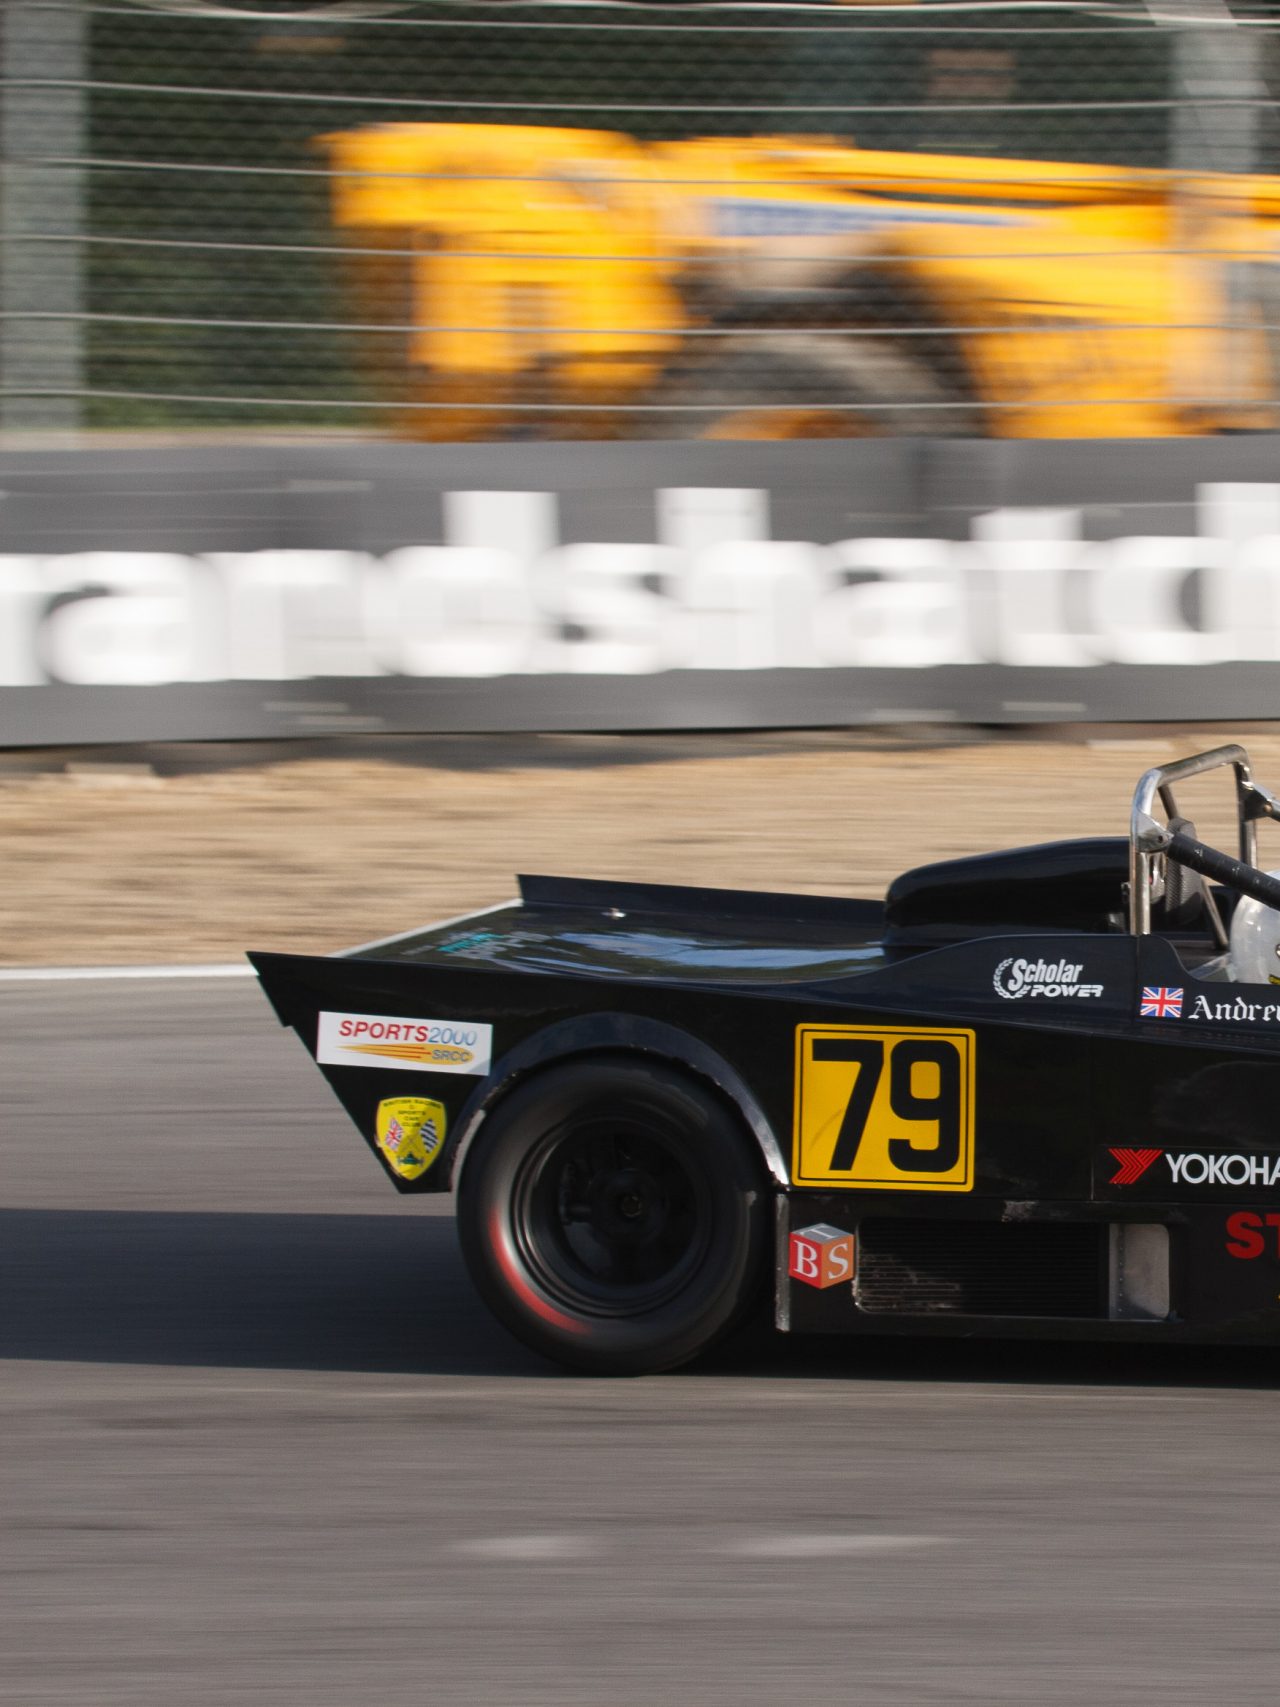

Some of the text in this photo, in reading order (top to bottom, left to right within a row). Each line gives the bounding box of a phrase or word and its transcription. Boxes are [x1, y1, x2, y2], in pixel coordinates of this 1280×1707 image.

[1007, 958, 1084, 992] Scholar
[1030, 984, 1104, 997] POWER
[431, 1049, 471, 1063] SRCC
[811, 1038, 961, 1174] 79
